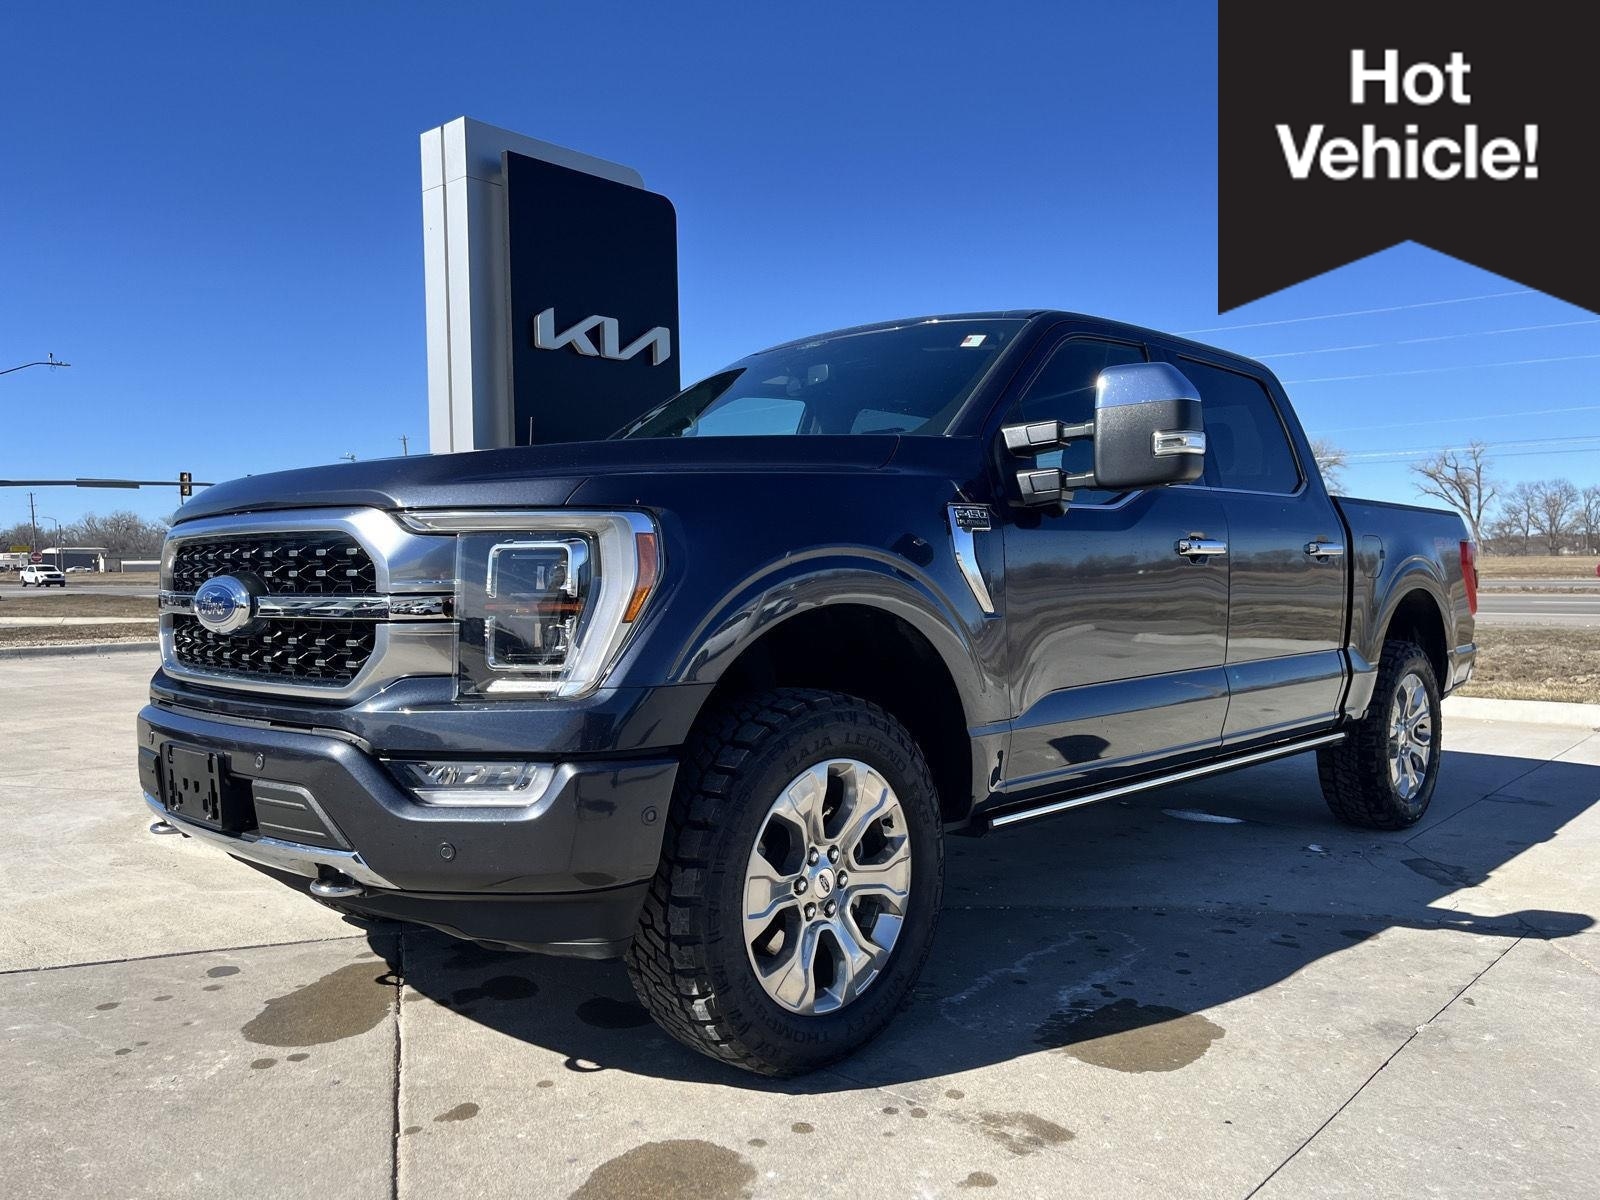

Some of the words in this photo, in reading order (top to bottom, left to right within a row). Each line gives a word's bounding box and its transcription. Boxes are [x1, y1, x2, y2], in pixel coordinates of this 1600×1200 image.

[534, 307, 671, 367] KIA
[785, 735, 833, 772] BAJA
[844, 732, 907, 772] LEGEND
